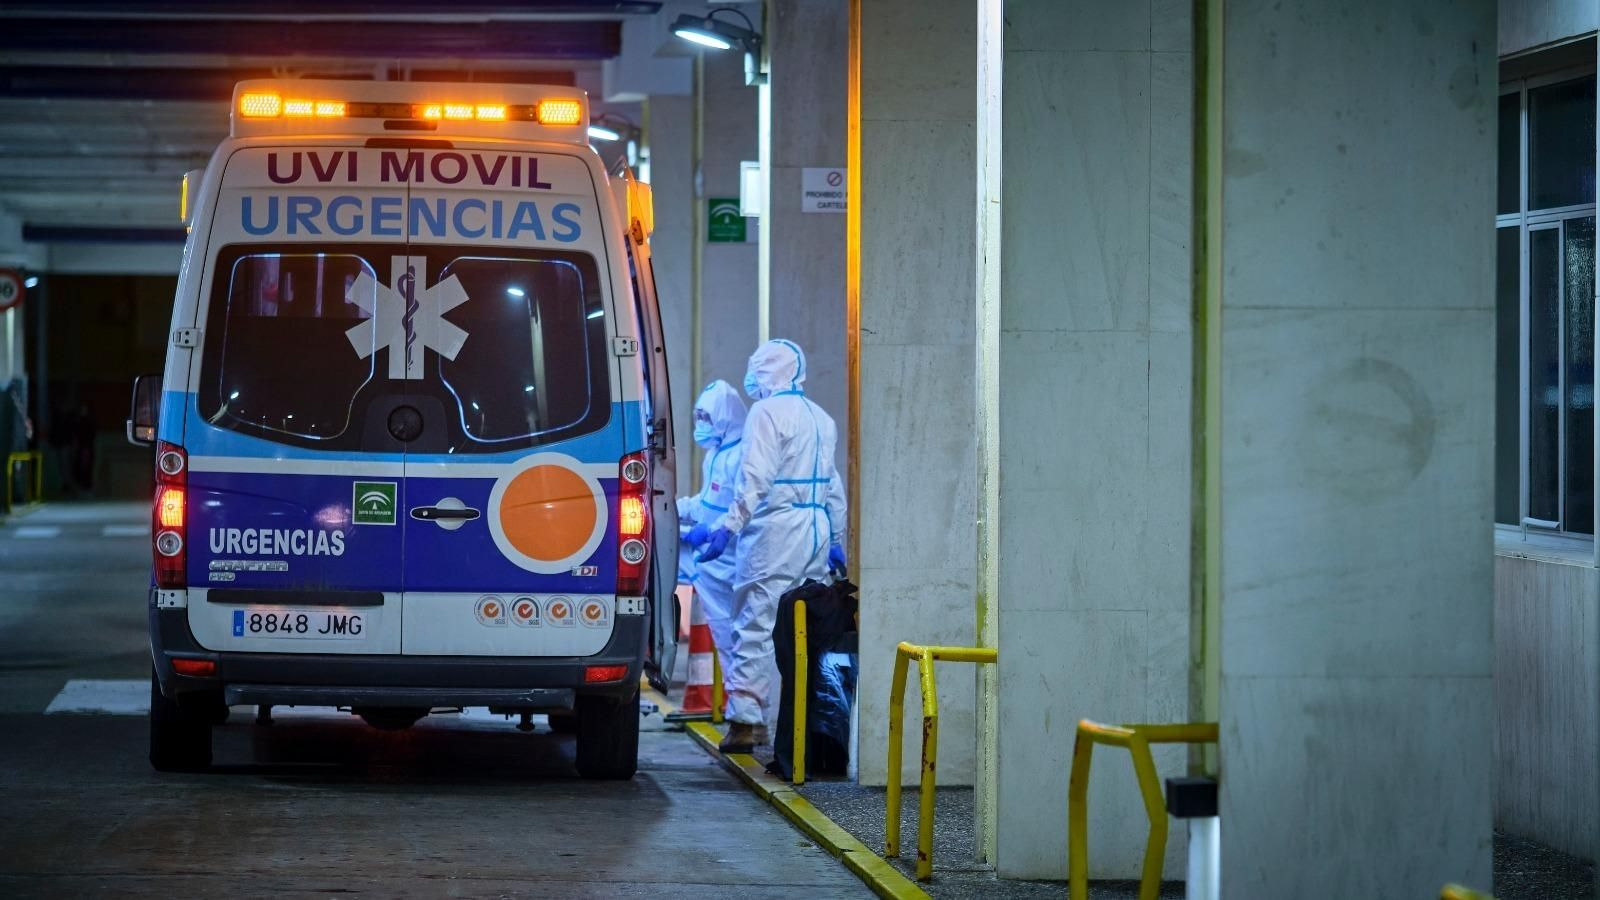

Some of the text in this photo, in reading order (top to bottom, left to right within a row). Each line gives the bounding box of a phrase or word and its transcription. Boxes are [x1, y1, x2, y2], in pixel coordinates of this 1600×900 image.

[267, 151, 552, 190] UVI MOVIL
[241, 195, 582, 242] URGENCIAS
[209, 527, 345, 556] URGENCIAS
[208, 560, 289, 571] CRAFTER
[571, 566, 598, 577] TDI
[249, 613, 308, 634] 8848
[318, 614, 362, 636] JMG
